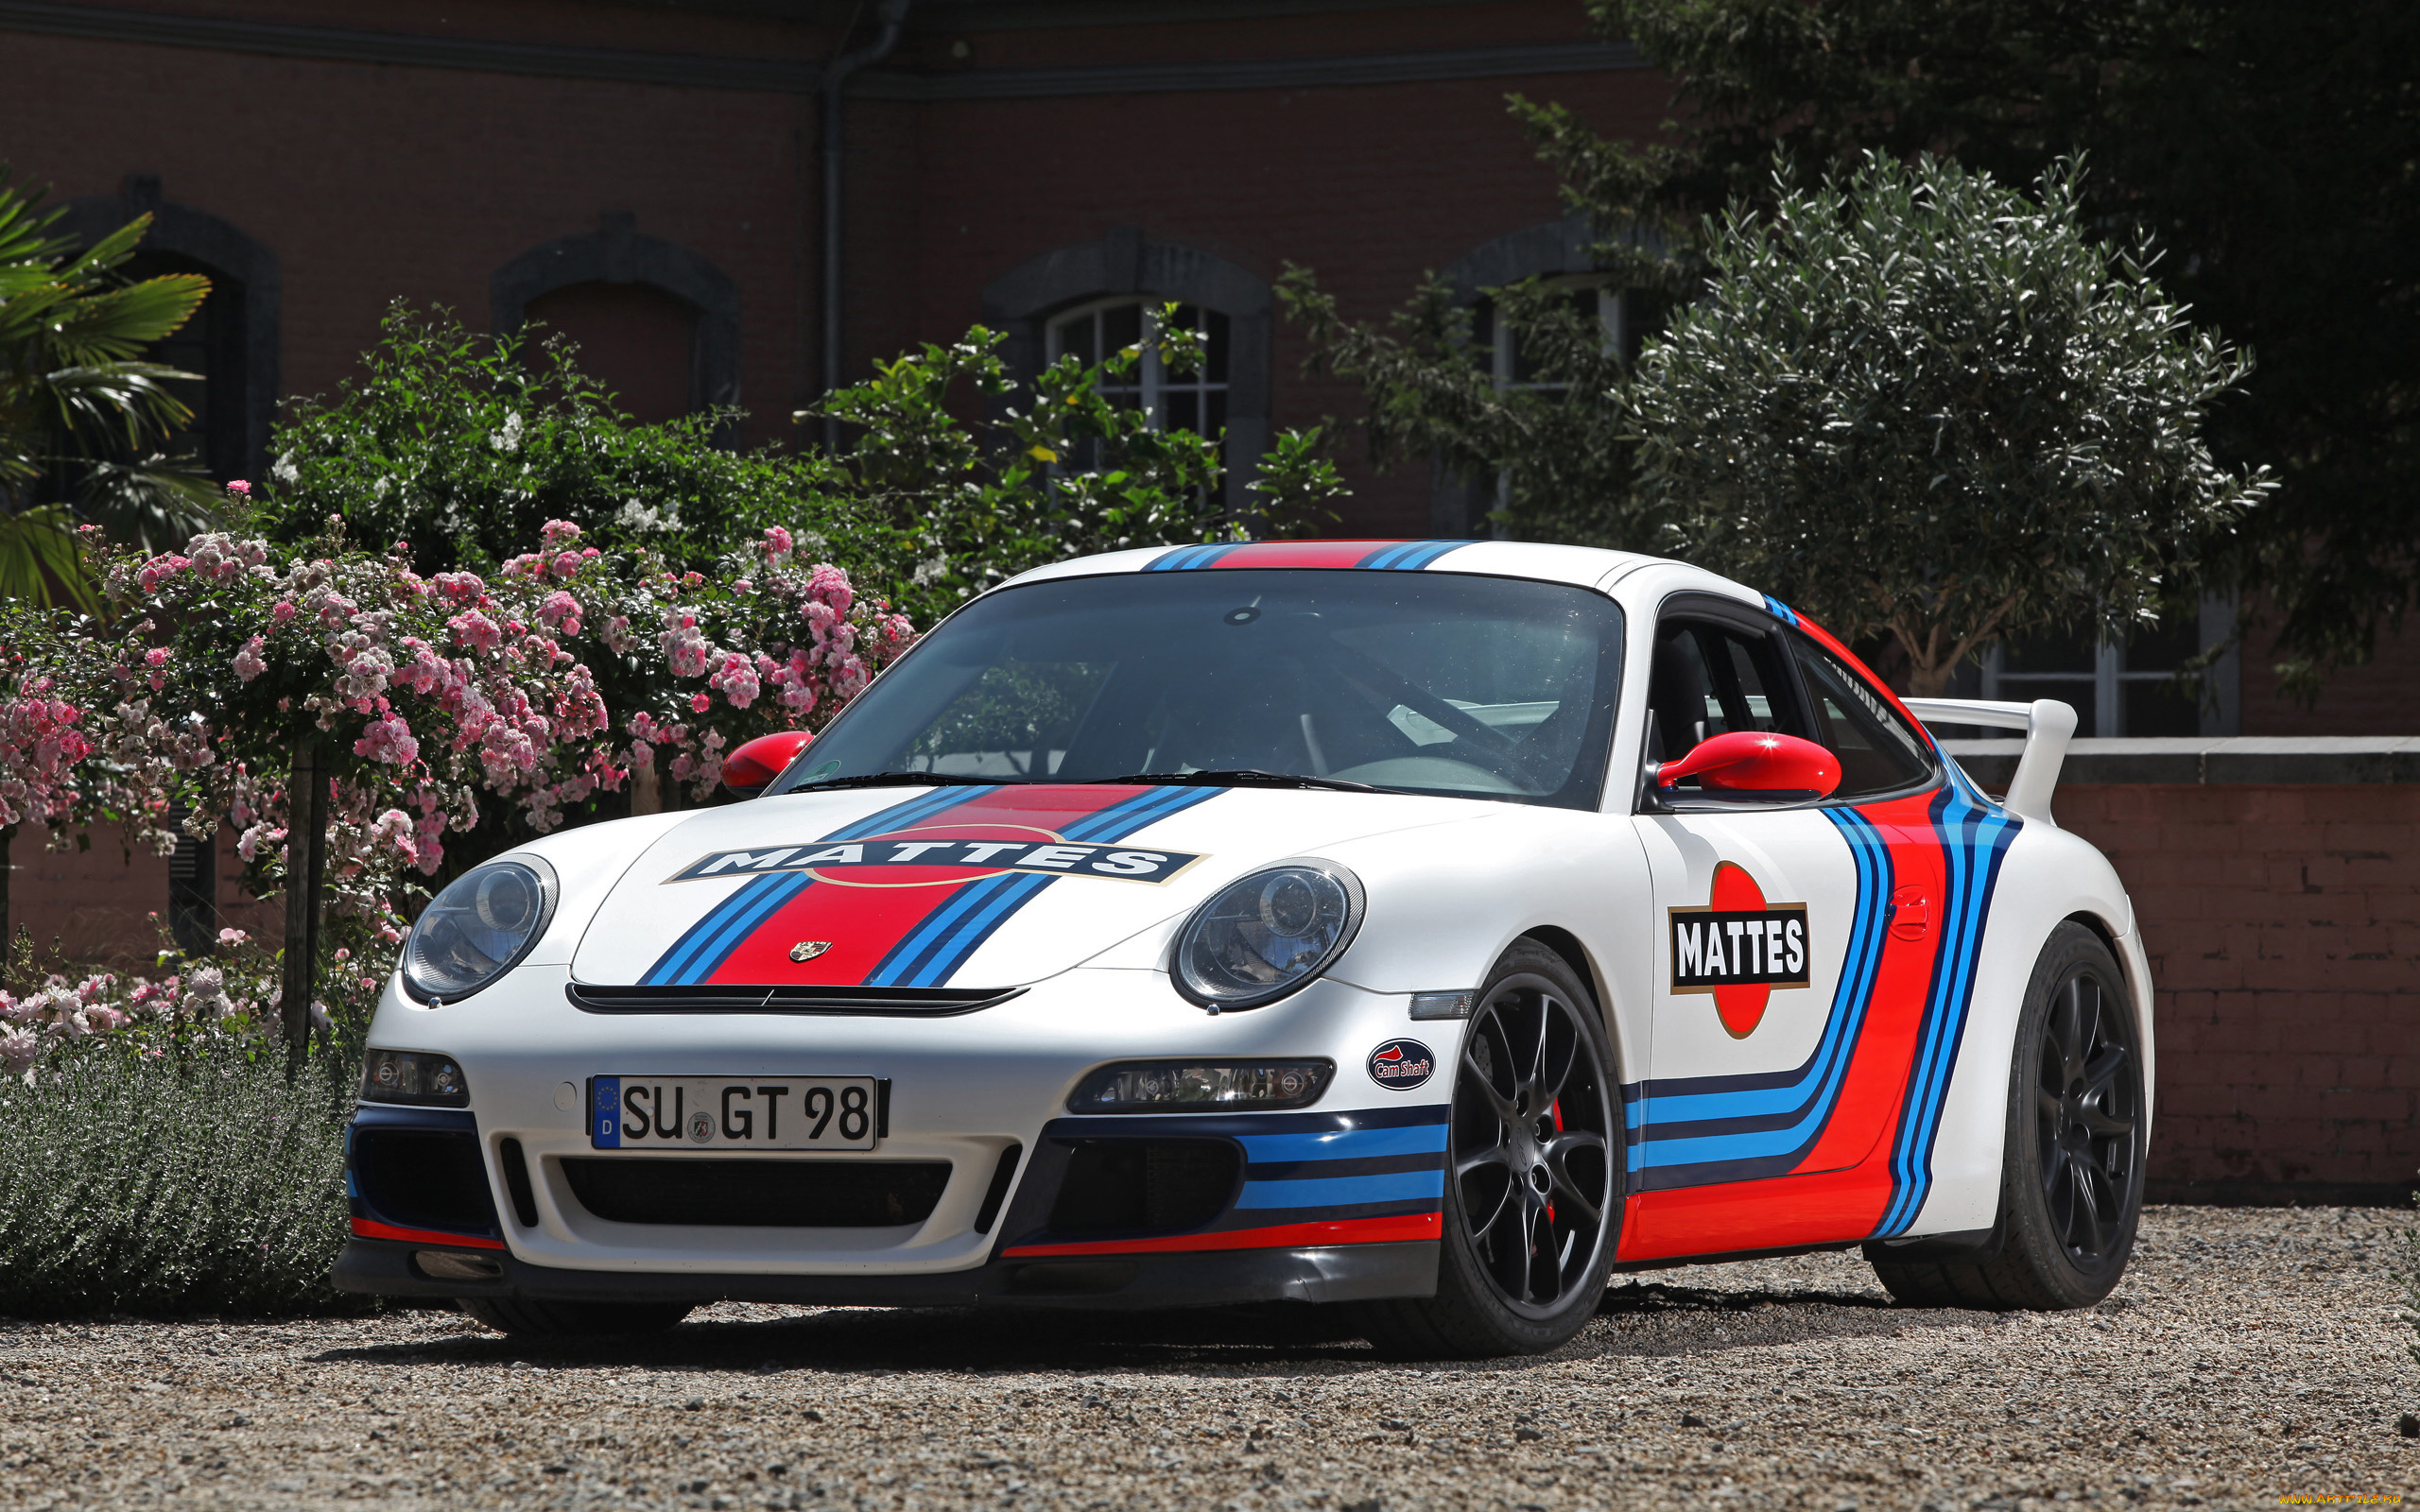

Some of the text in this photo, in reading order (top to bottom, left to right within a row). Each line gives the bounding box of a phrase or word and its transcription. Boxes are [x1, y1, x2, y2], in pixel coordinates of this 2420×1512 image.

[698, 842, 1168, 874] MATTES
[1677, 919, 1804, 976] MATTES
[1374, 1059, 1429, 1078] Cam Shaft
[601, 1120, 613, 1135] D
[622, 1086, 683, 1139] SU
[721, 1086, 789, 1139] GT
[804, 1086, 869, 1140] 98
